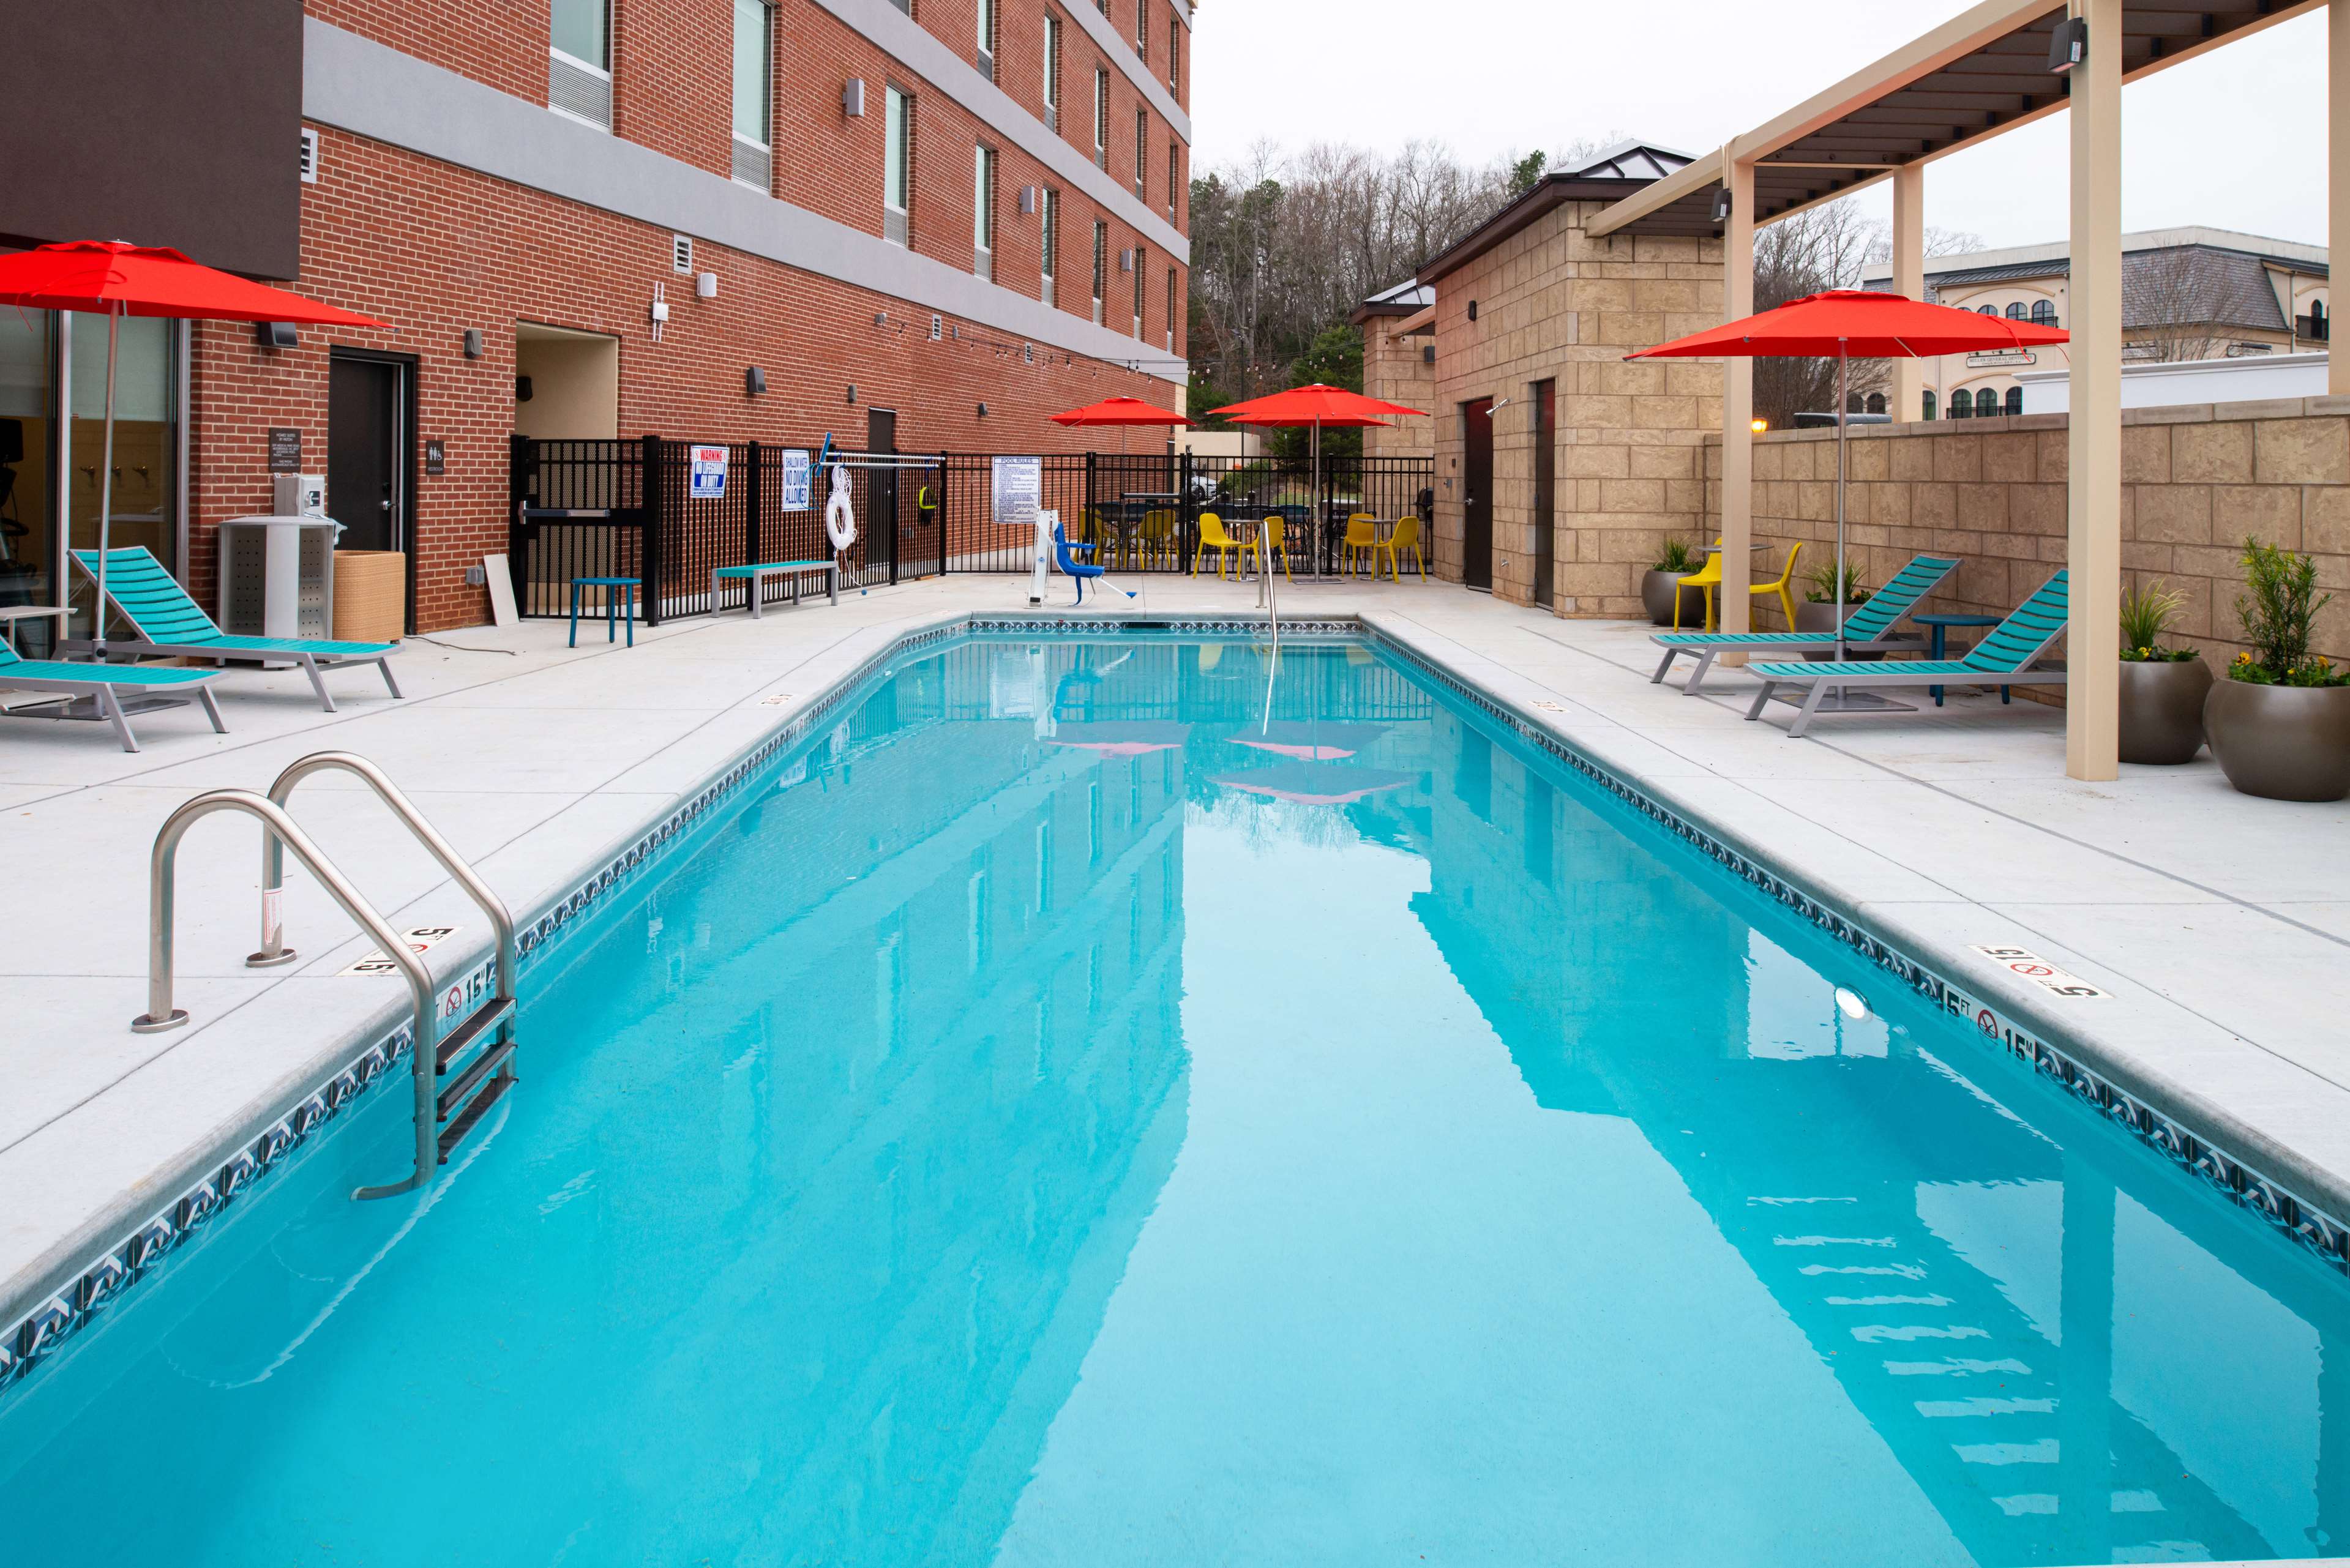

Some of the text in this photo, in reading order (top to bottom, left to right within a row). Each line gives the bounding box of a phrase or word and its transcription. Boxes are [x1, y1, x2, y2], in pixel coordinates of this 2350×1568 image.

[700, 449, 723, 461] WARNING
[695, 462, 725, 475] NO LIFEGUARD
[701, 475, 719, 487] ON DUTY
[786, 470, 792, 486] NO
[785, 488, 807, 504] ALLOWED
